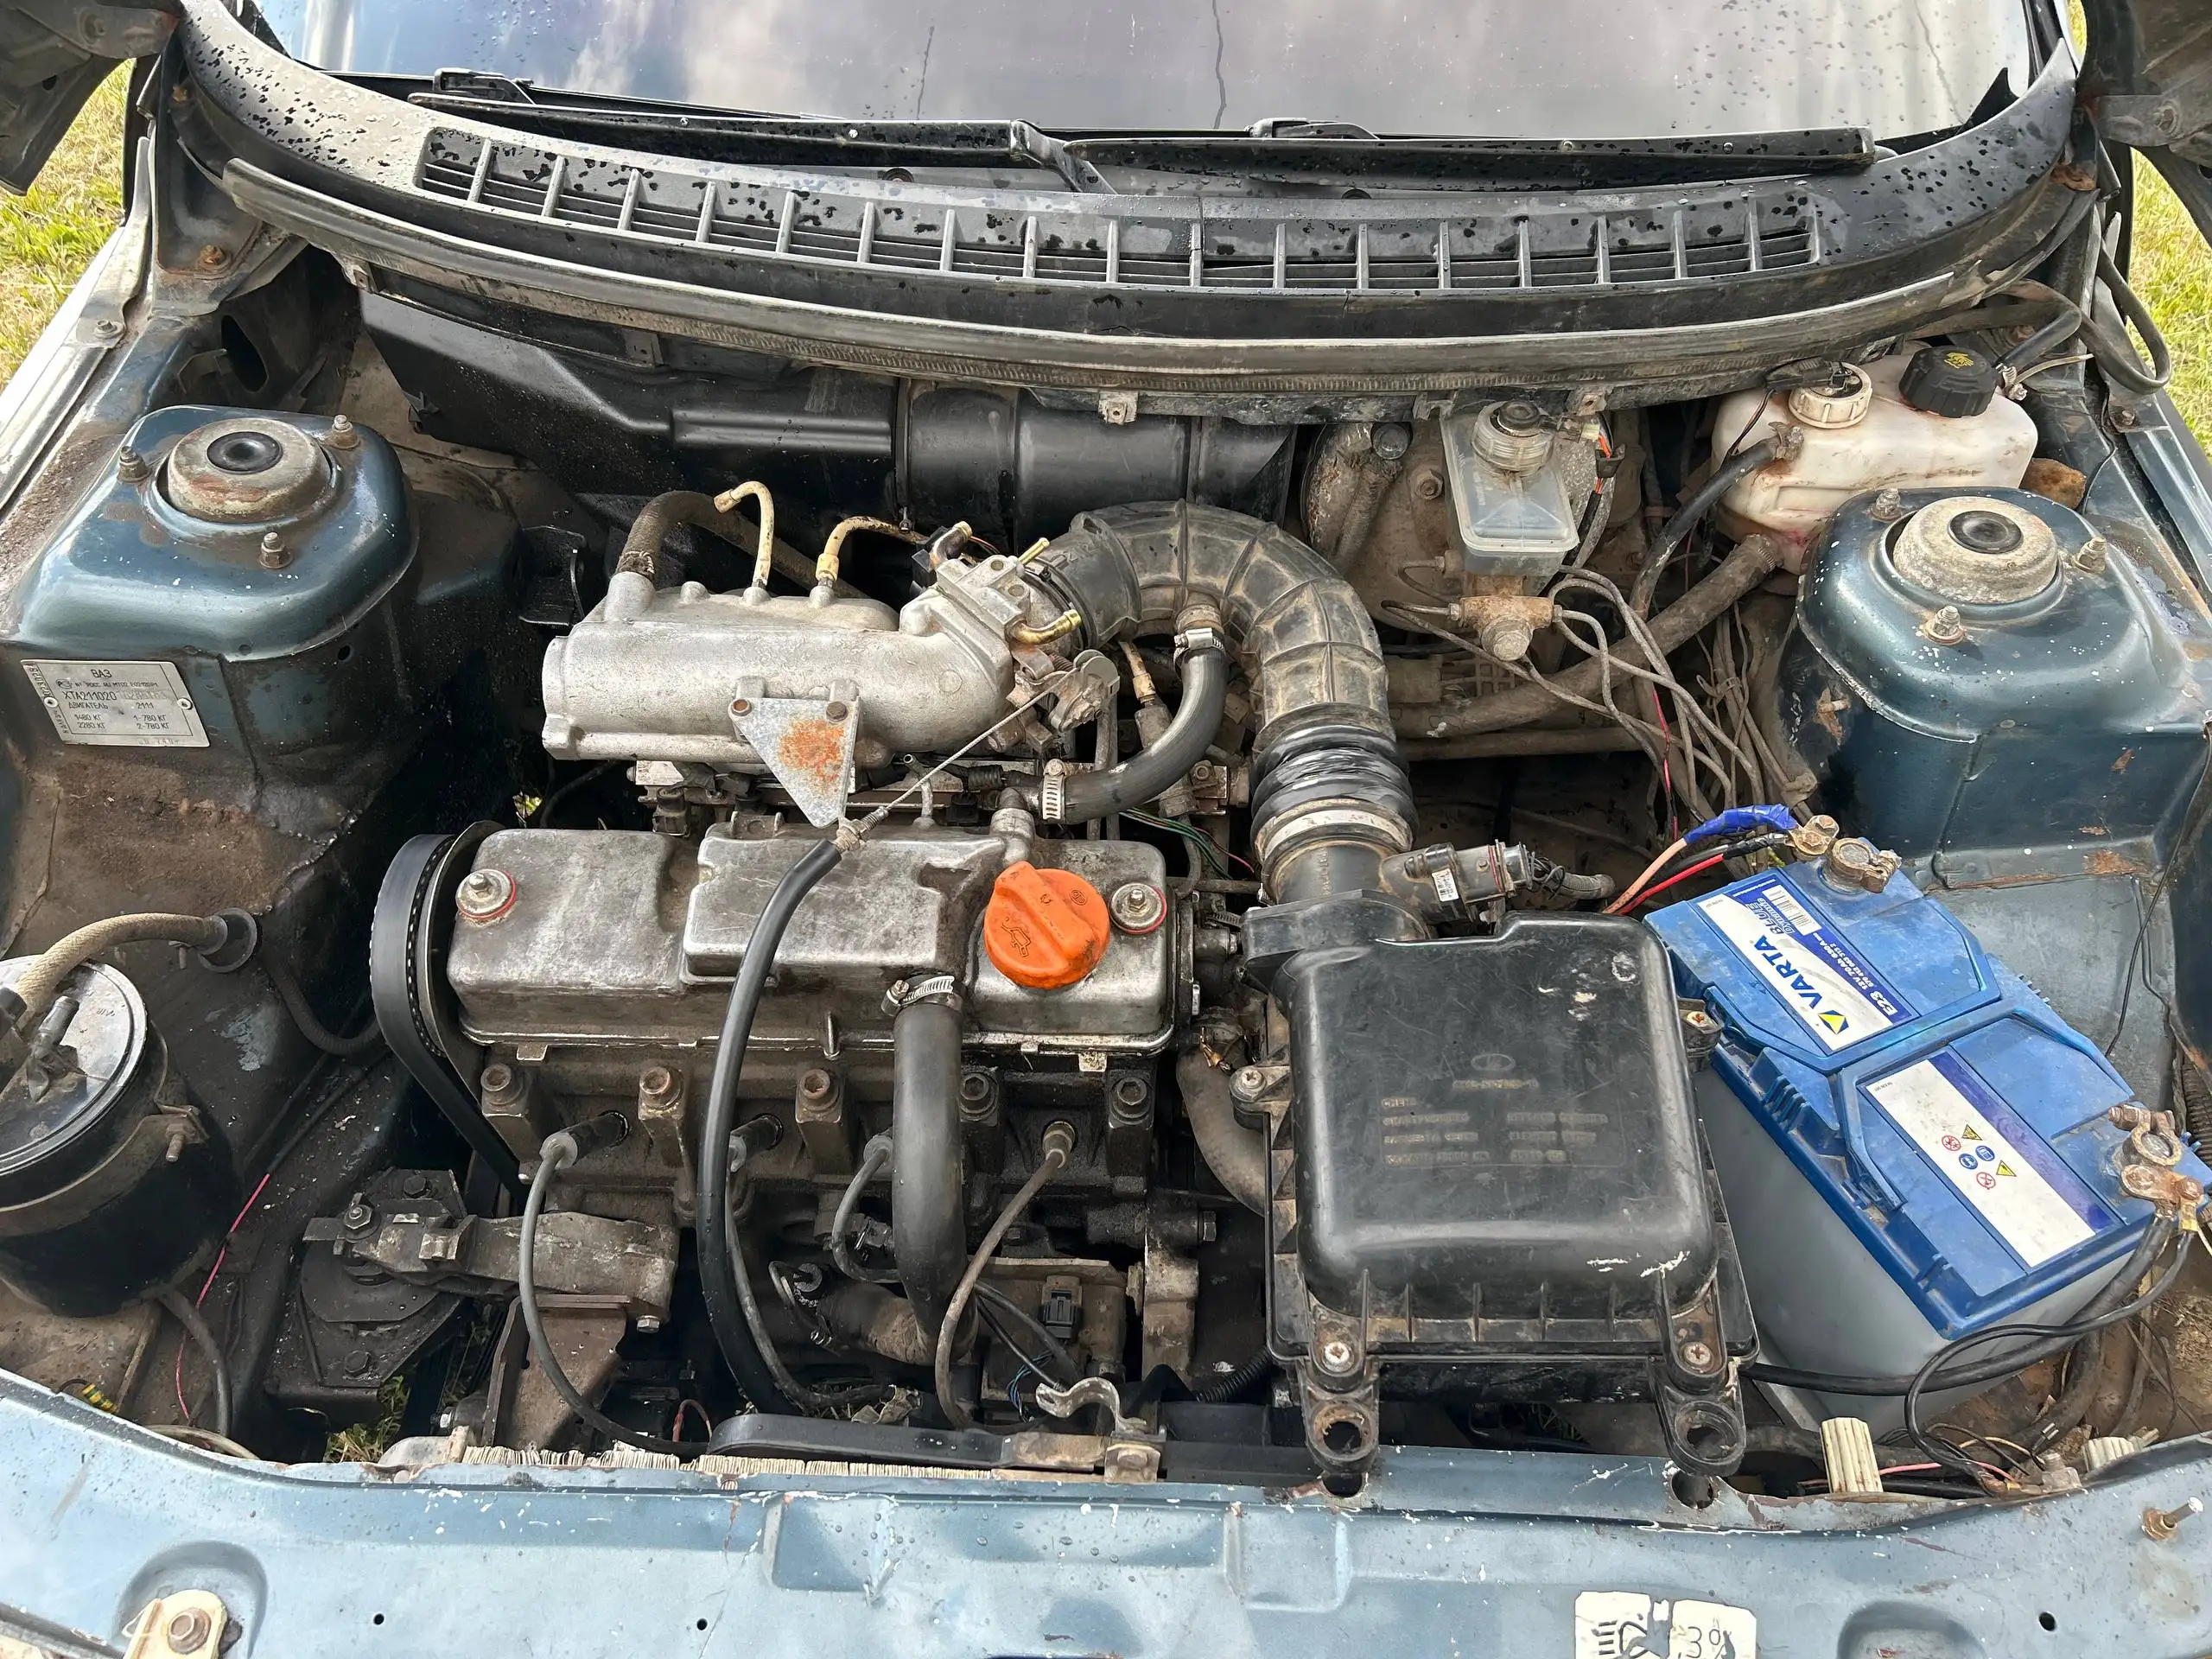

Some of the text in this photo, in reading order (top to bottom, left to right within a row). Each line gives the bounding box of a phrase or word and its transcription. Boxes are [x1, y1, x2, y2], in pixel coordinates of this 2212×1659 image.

[90, 669, 112, 678] ВАЗ
[1746, 902, 1785, 934] BLUE
[1754, 934, 1823, 1009] VARTA
[1837, 958, 1855, 976] 70Ah
[1853, 976, 1868, 990] 12V
[1870, 990, 1898, 1015] E23
